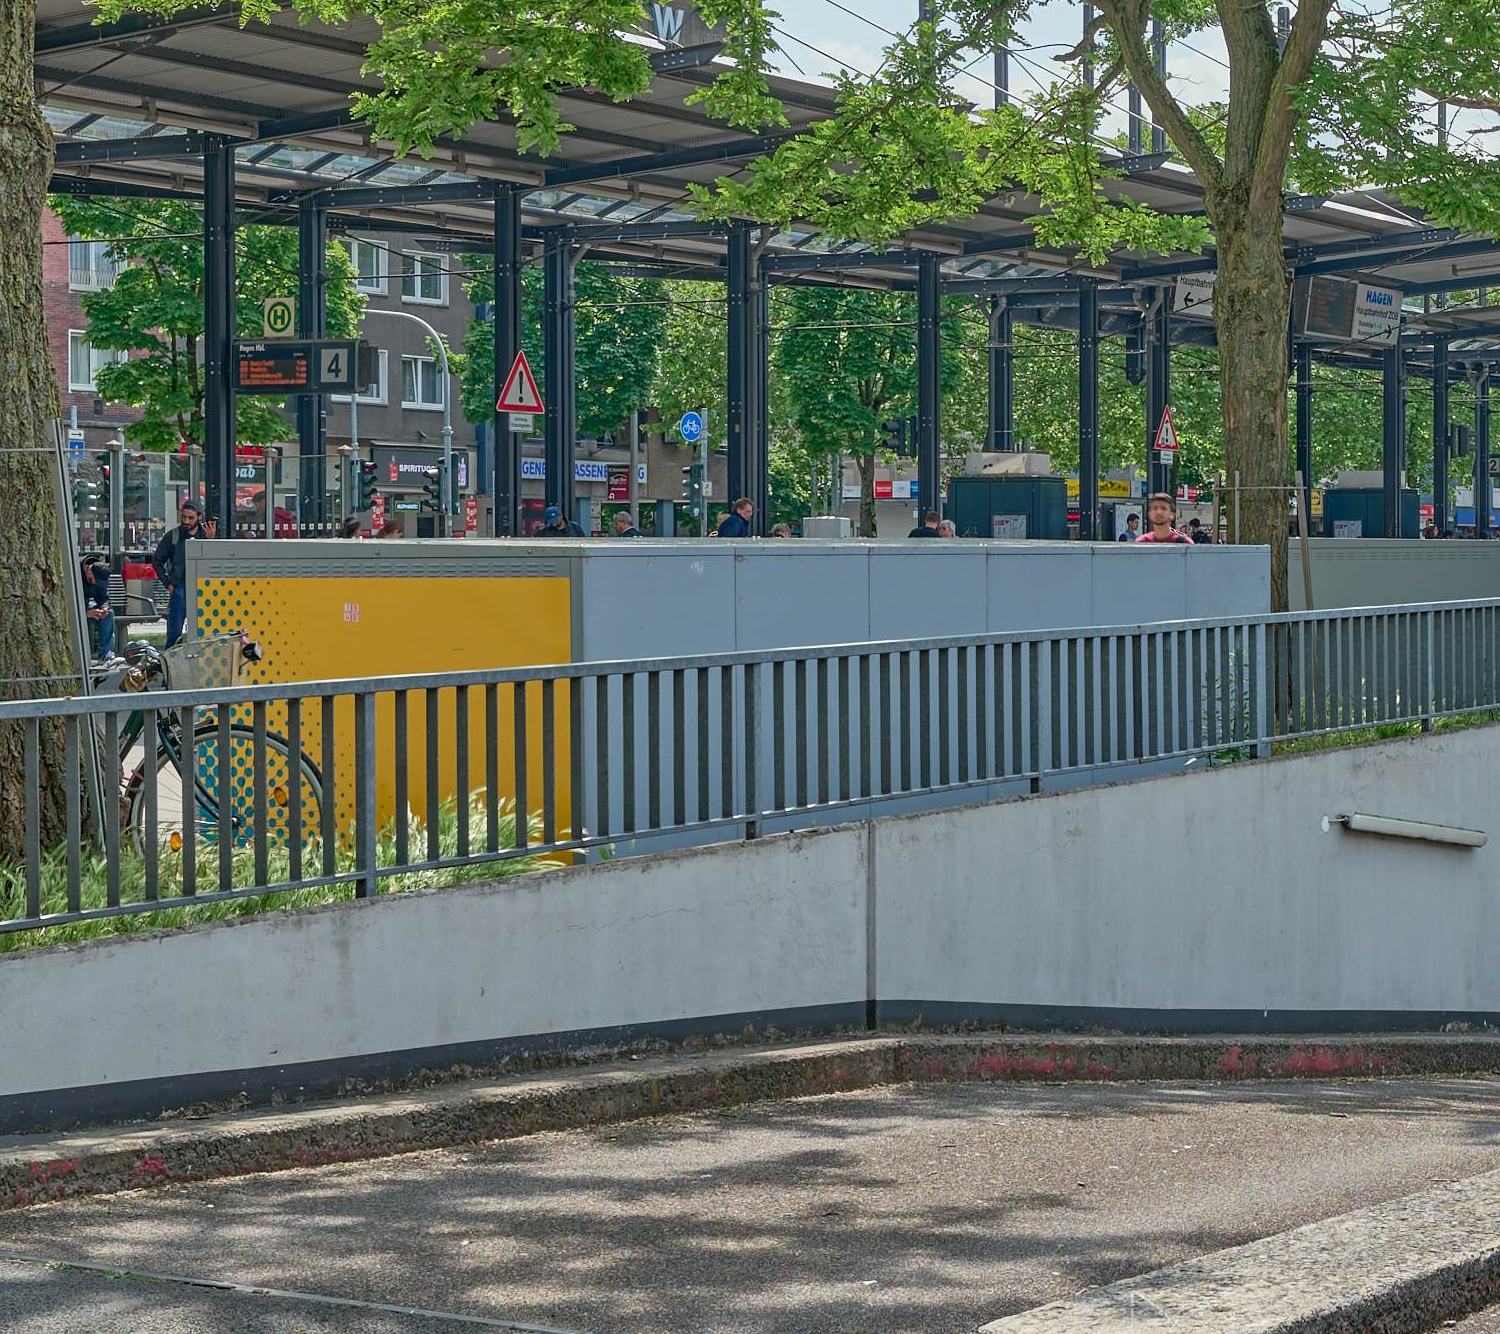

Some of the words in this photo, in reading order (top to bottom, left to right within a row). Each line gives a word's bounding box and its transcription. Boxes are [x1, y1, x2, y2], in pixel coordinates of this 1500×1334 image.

[1366, 290, 1393, 307] HAGEN
[273, 308, 286, 326] H
[327, 353, 342, 378] 4
[1490, 460, 1498, 471] 2
